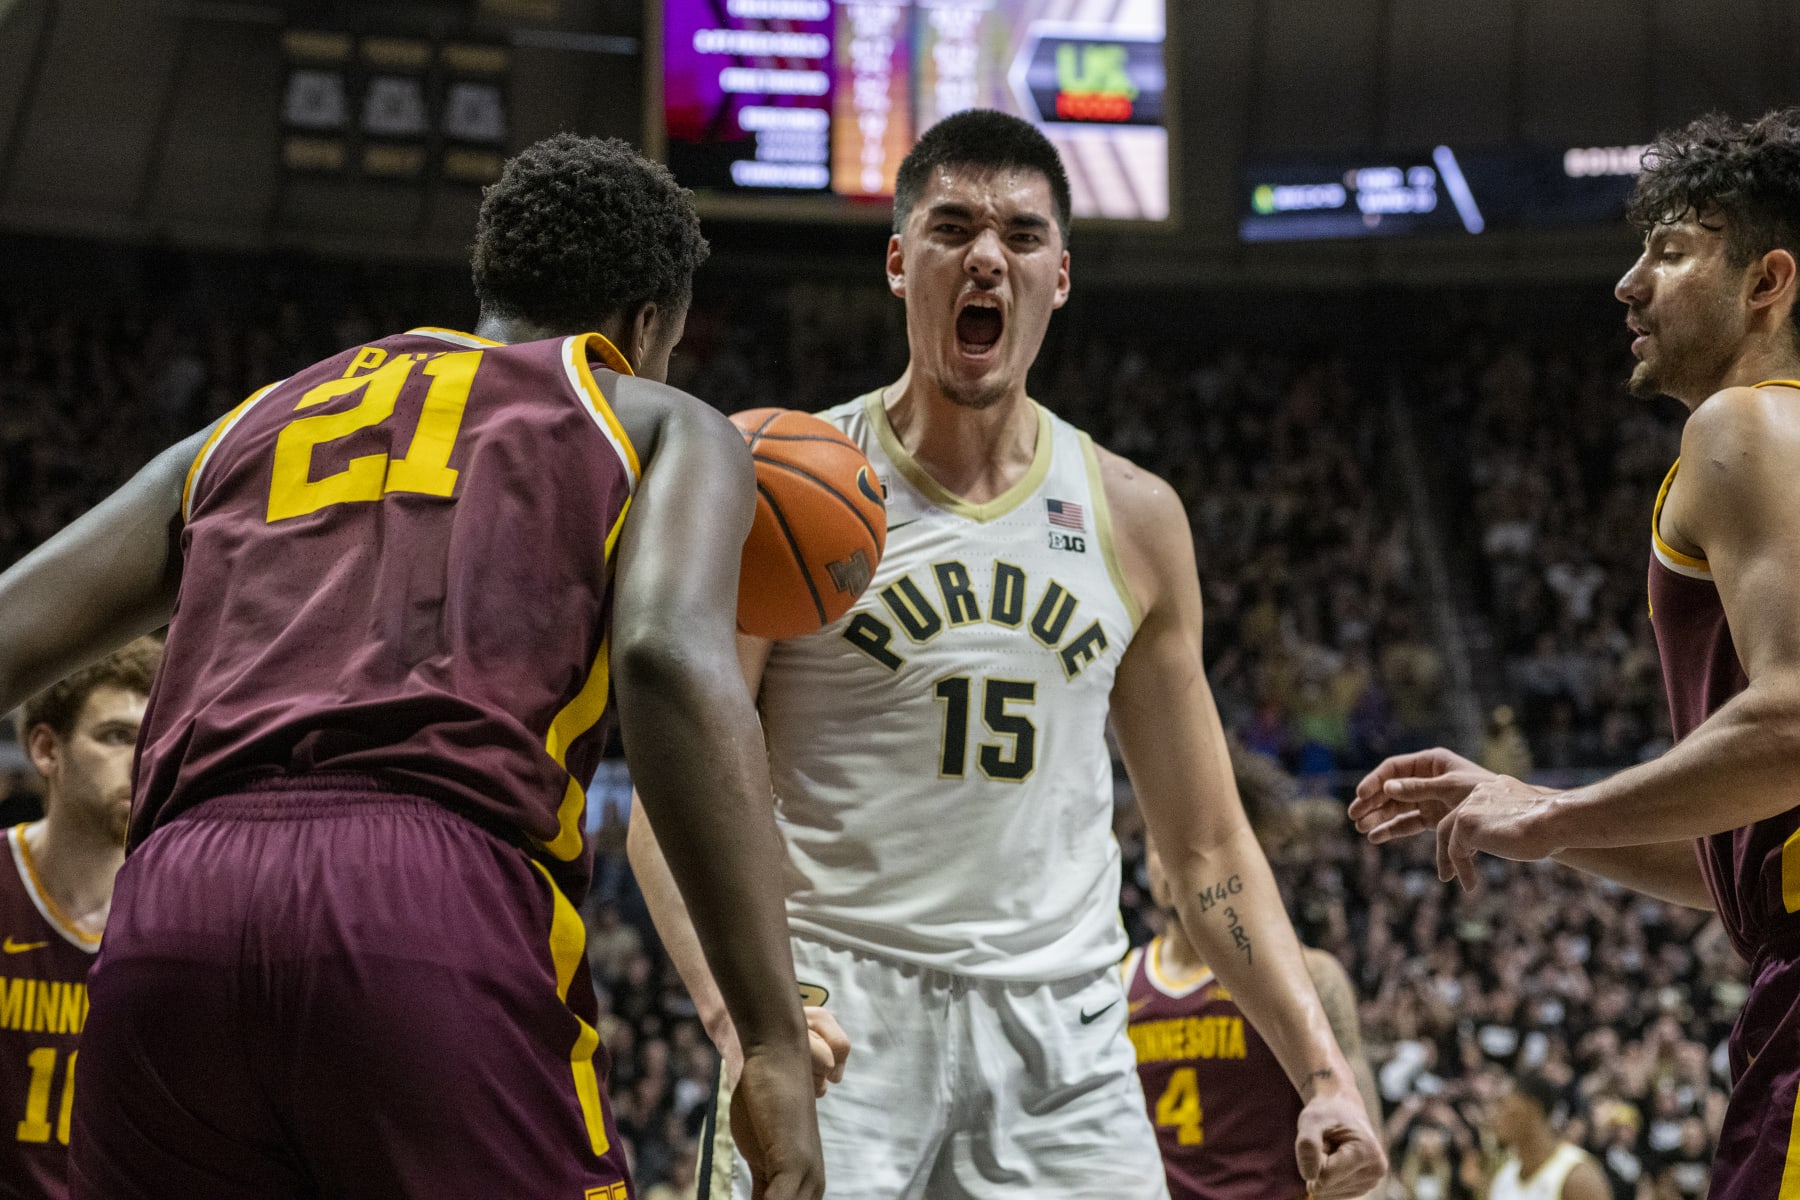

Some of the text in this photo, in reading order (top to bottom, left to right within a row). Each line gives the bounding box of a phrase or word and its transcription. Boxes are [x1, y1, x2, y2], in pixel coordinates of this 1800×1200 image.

[266, 350, 484, 524] 21
[841, 559, 1110, 683] PURDUE
[933, 674, 1037, 784] 15
[1197, 874, 1243, 912] M4G
[0, 976, 89, 1034] MINN
[1156, 1067, 1203, 1146] 4
